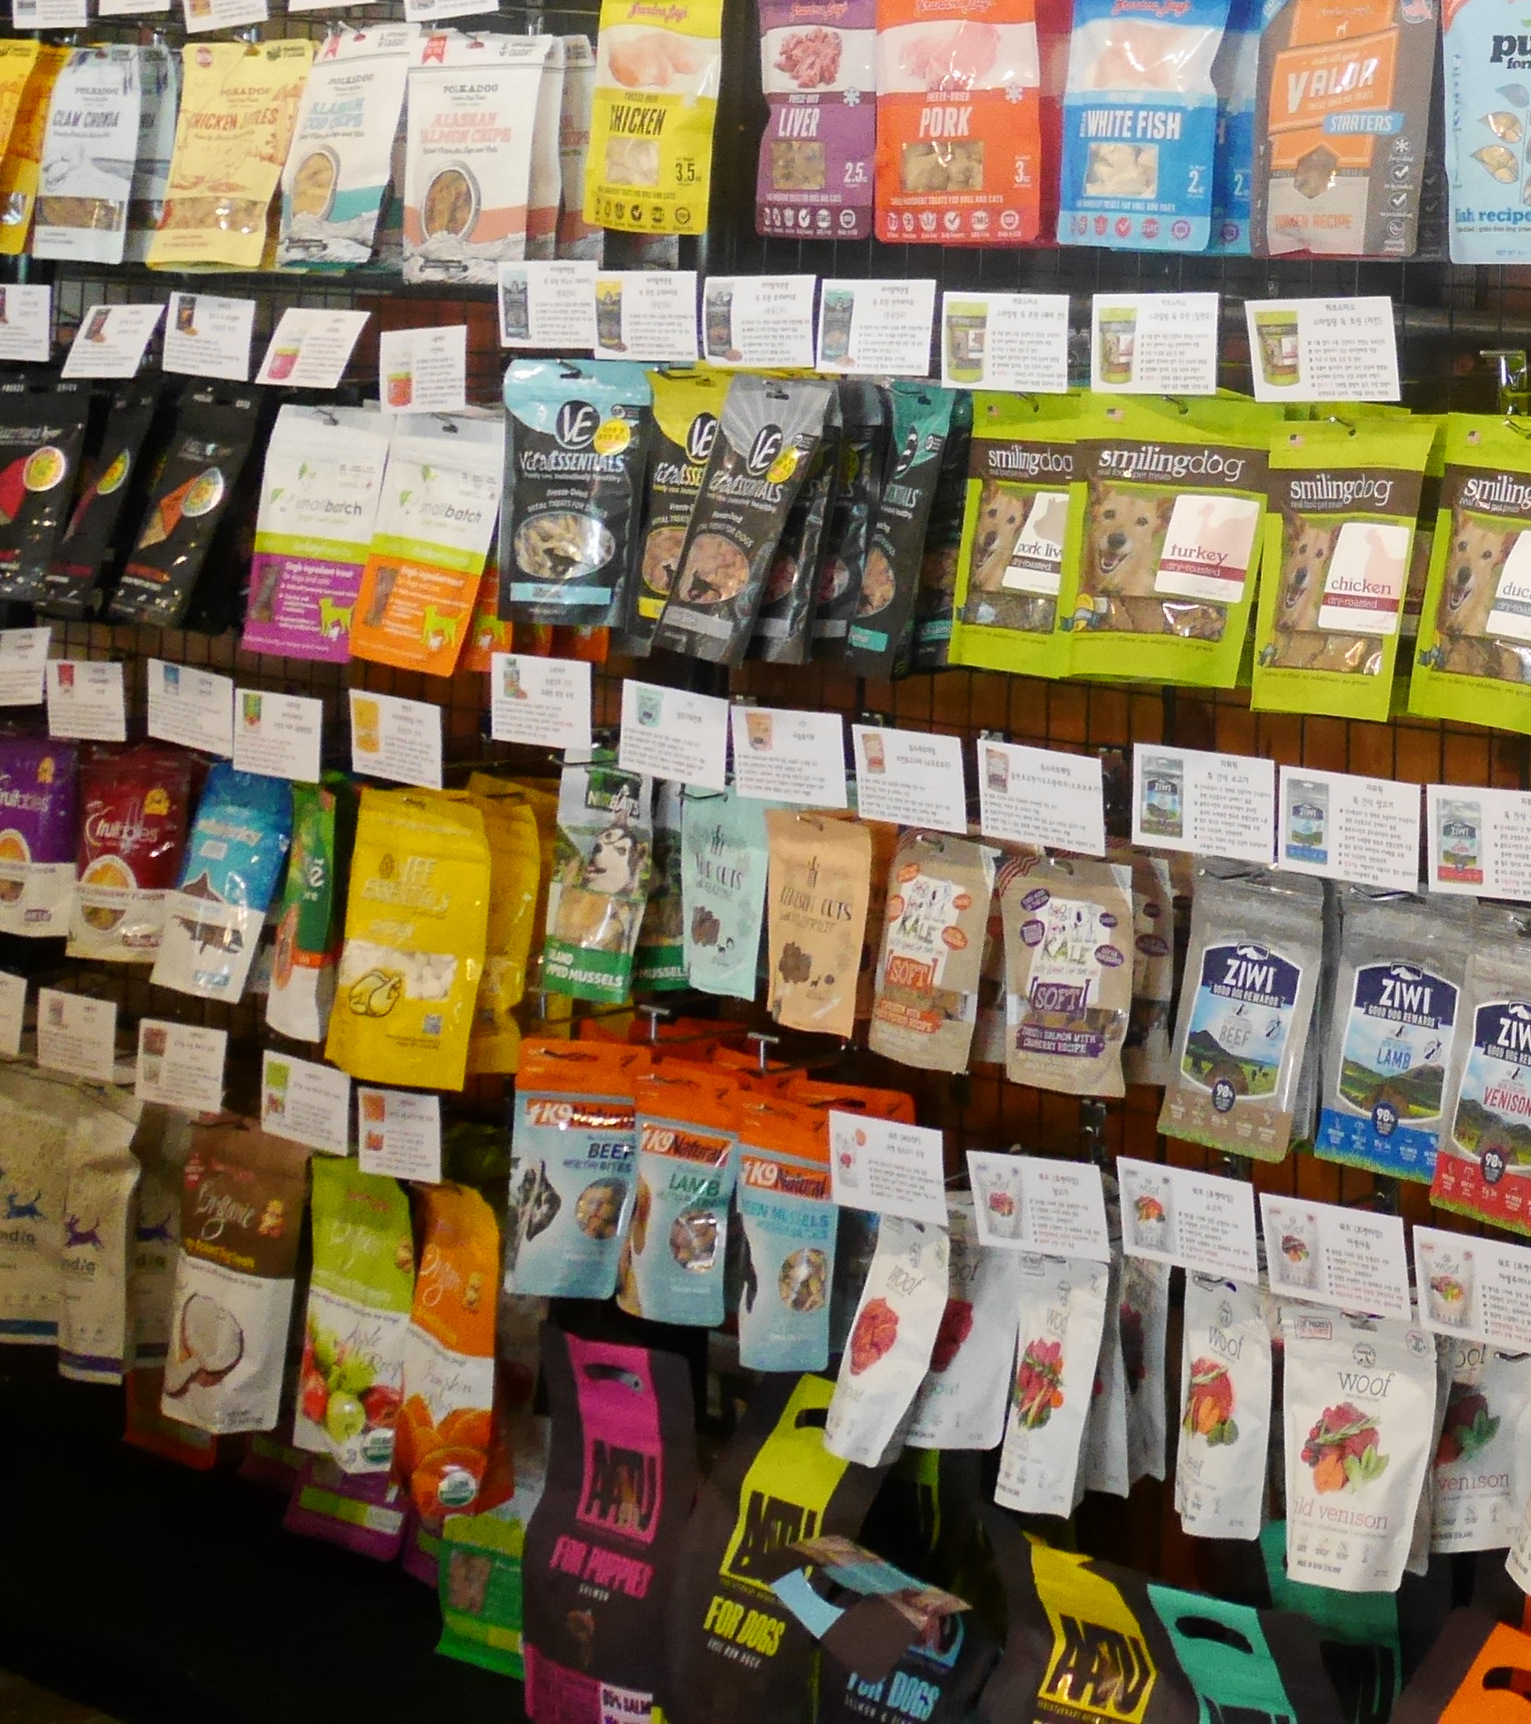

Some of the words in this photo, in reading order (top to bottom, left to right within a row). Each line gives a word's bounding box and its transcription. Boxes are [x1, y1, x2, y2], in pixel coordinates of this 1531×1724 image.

[778, 107, 820, 137] LIVER
[919, 106, 972, 137] PORK
[1086, 111, 1138, 139] WHITE
[1141, 111, 1182, 139] FISH
[1098, 445, 1246, 483] smilingdog
[1290, 473, 1394, 507] smilingdog
[1170, 543, 1228, 565] turkey
[1331, 577, 1392, 595] chicken
[1223, 959, 1276, 994] ZIWI
[1380, 979, 1433, 1012] ZIWI
[1376, 1047, 1412, 1069] LAMB
[1337, 1372, 1395, 1397] woof
[1318, 1504, 1388, 1530] venison
[704, 1595, 737, 1636] FOR
[740, 1610, 786, 1657] DOGS
